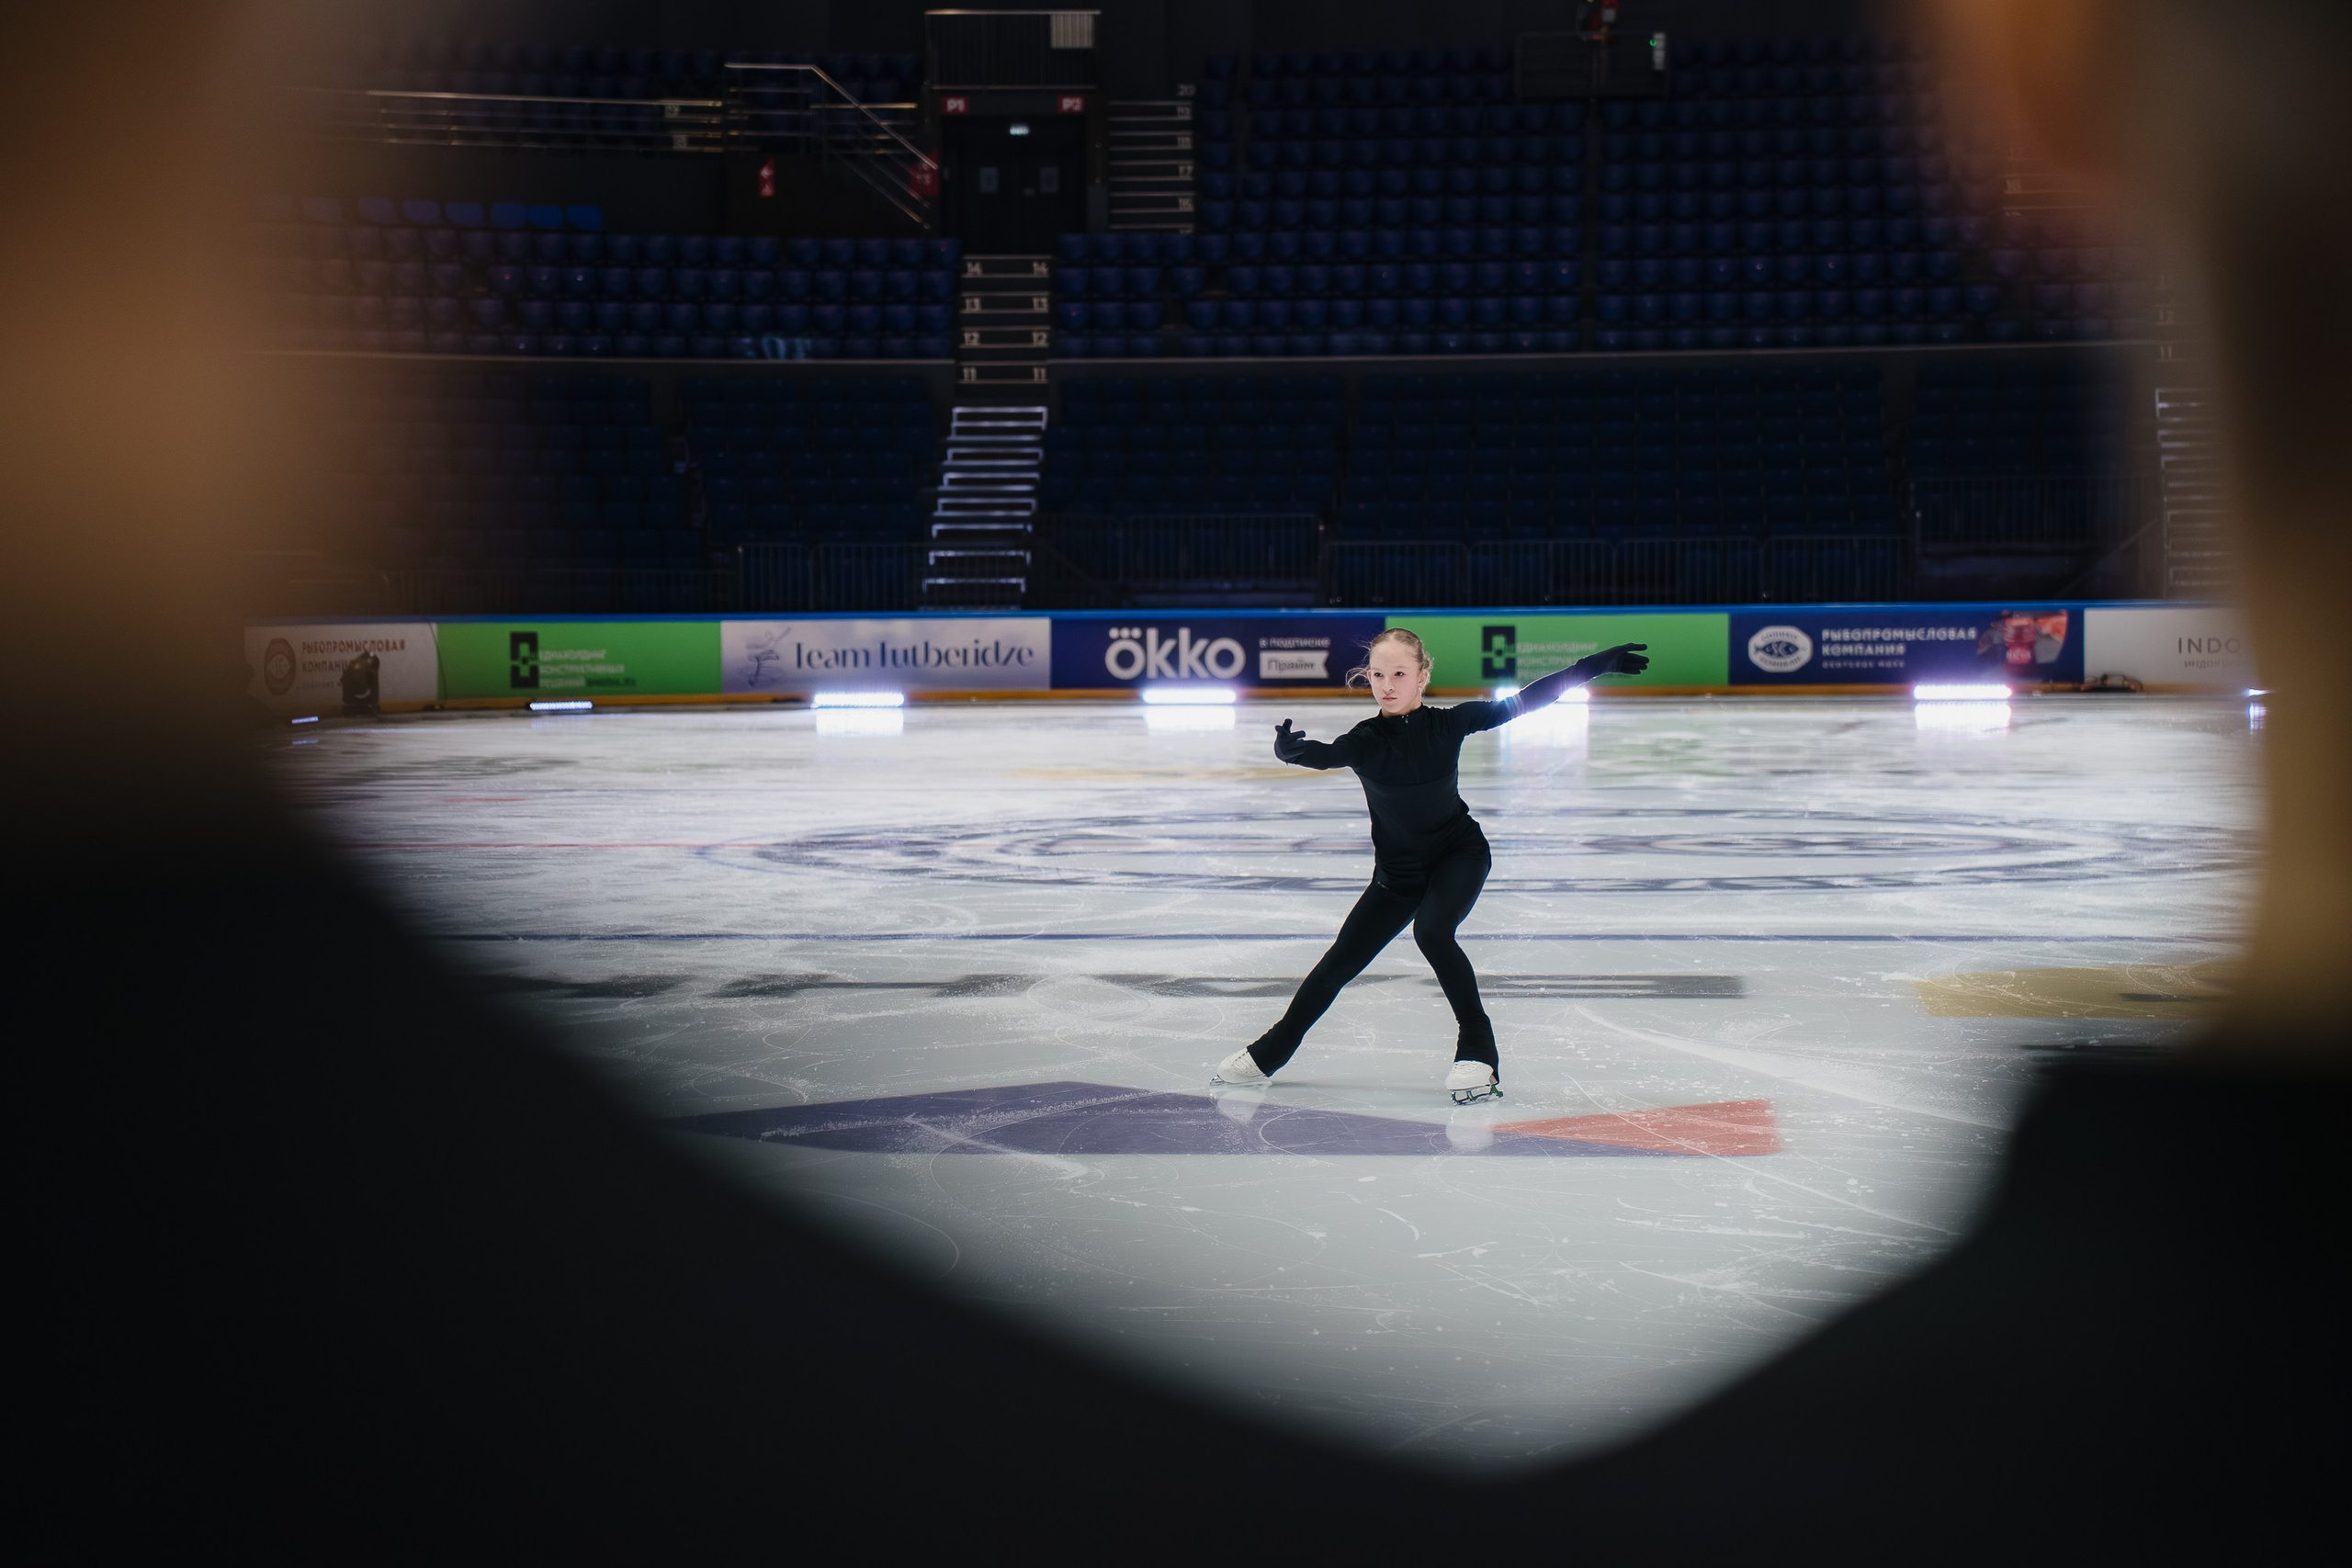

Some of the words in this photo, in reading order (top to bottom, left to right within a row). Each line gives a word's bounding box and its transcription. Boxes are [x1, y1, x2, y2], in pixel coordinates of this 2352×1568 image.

[967, 261, 982, 275] 14
[1033, 261, 1048, 275] 14
[965, 297, 981, 310] 13
[1033, 297, 1048, 310] 13
[964, 332, 979, 345] 12
[1032, 332, 1047, 345] 12
[963, 367, 977, 381] 11
[1033, 367, 1046, 381] 11
[1822, 626, 1977, 642] РЫБОПРОМЫСЛОВАЯ
[301, 639, 405, 654] РЫБОПРОМЫСЛОВАЯ
[1822, 643, 1906, 657] КОМПАНИЯ
[301, 659, 349, 673] КОМПАНИ
